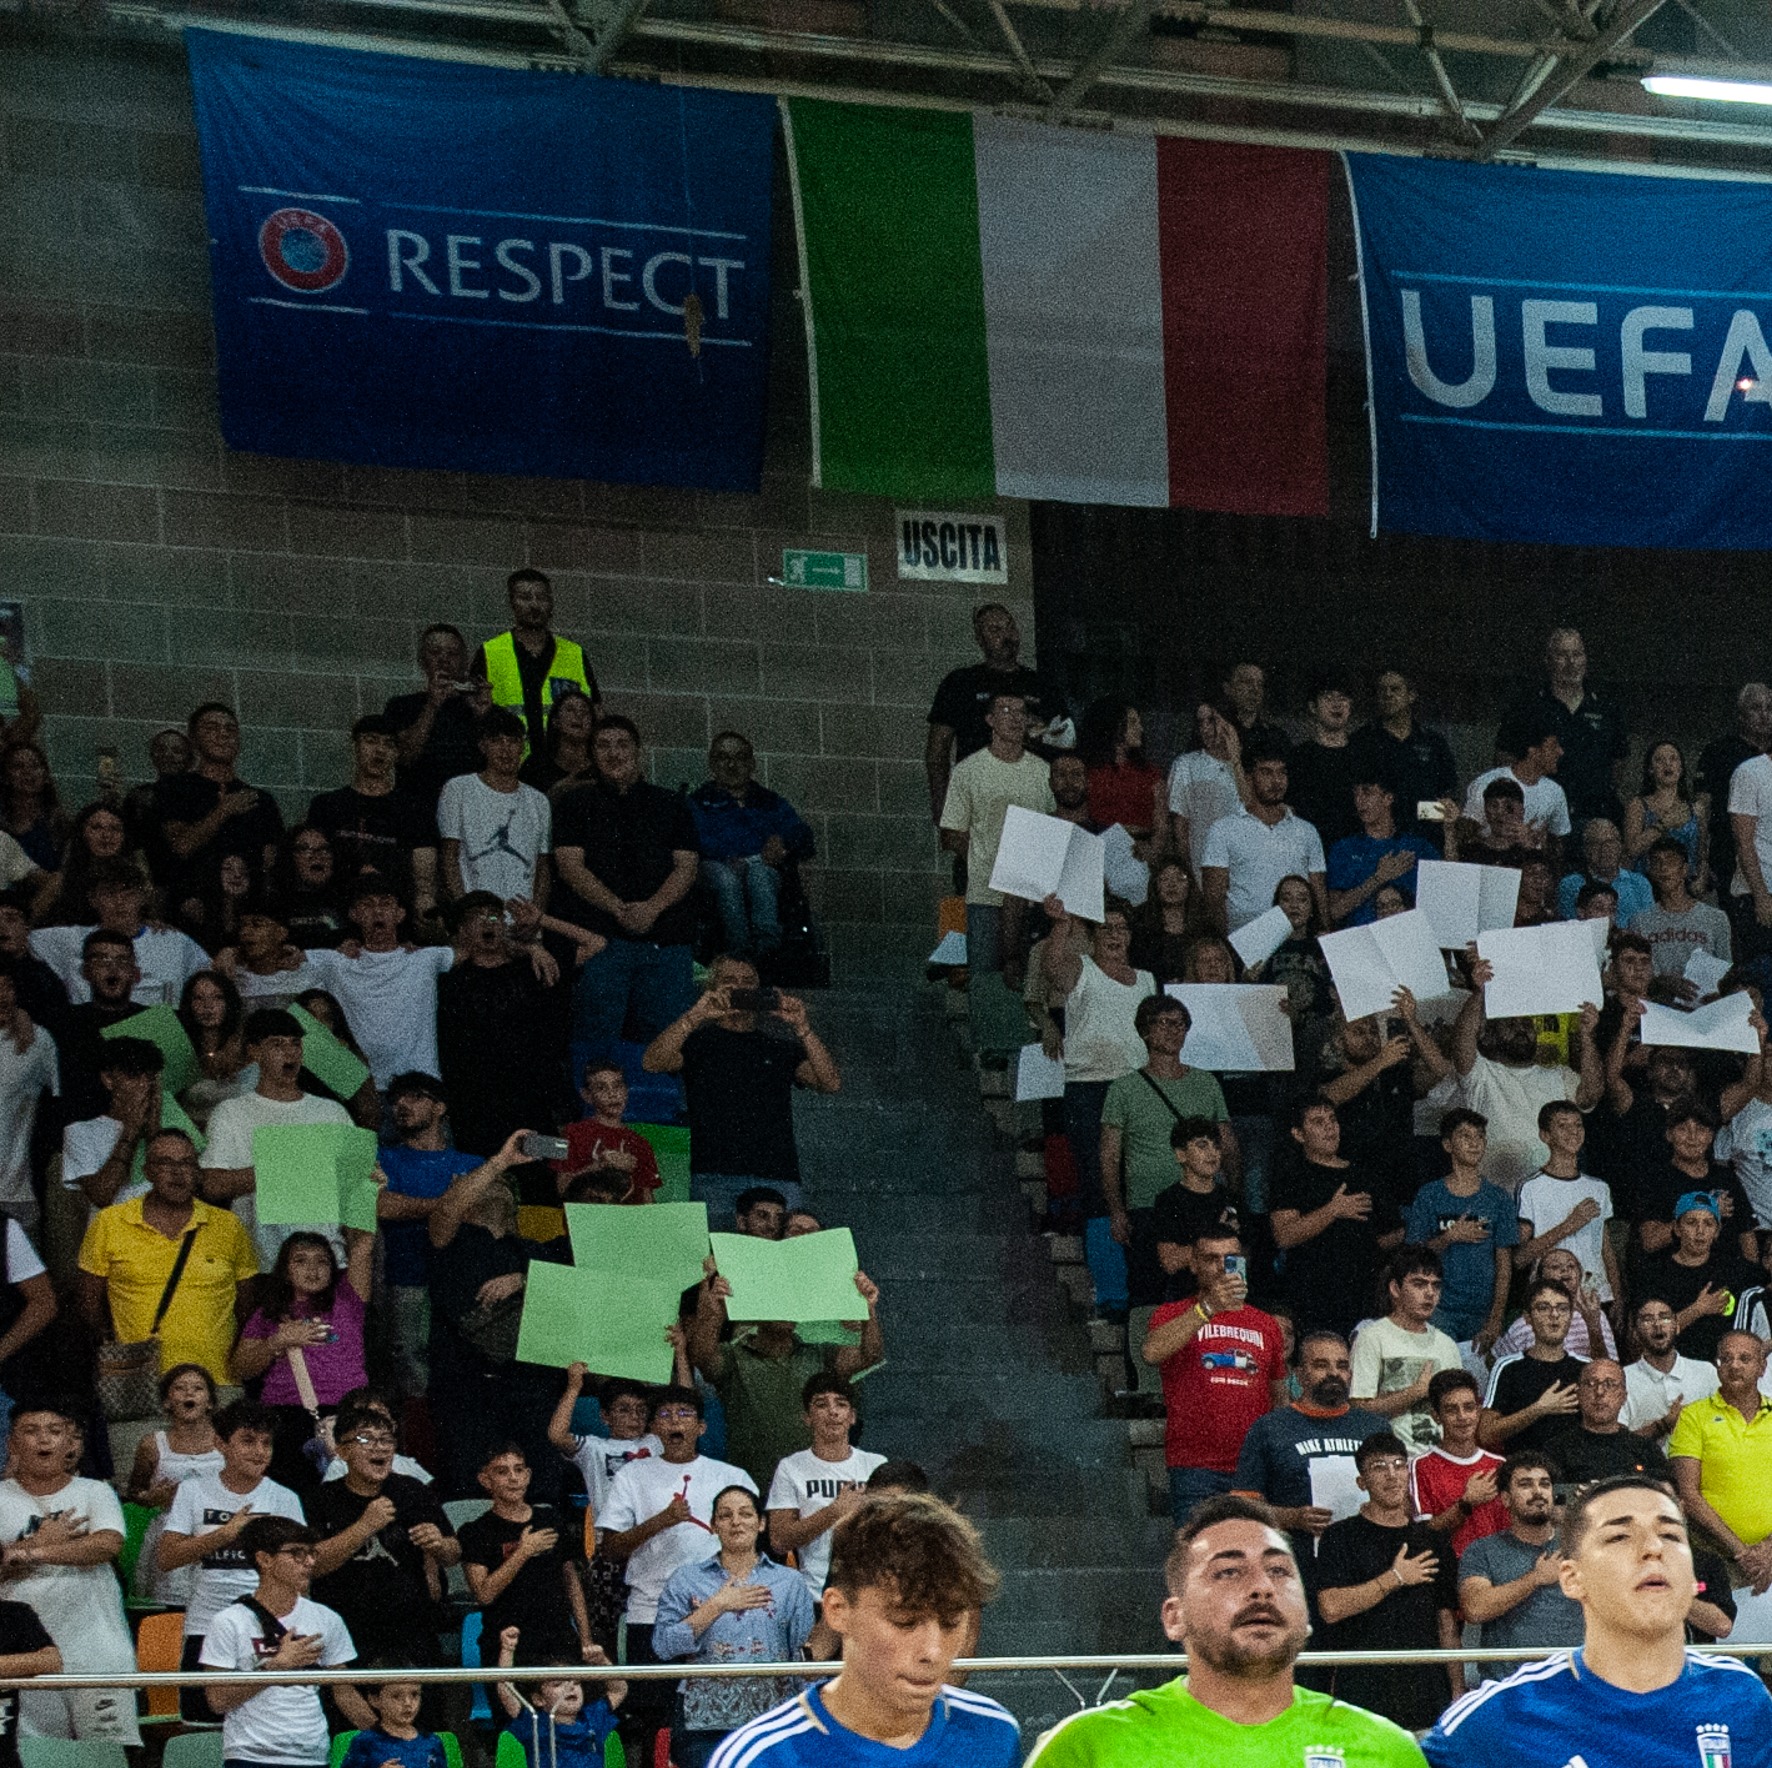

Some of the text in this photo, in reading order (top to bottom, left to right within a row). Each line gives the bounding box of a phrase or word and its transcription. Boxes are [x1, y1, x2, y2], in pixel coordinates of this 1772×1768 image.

[386, 228, 746, 320] RESPECT
[903, 520, 1001, 570] USCITA
[1648, 926, 1709, 944] adidas
